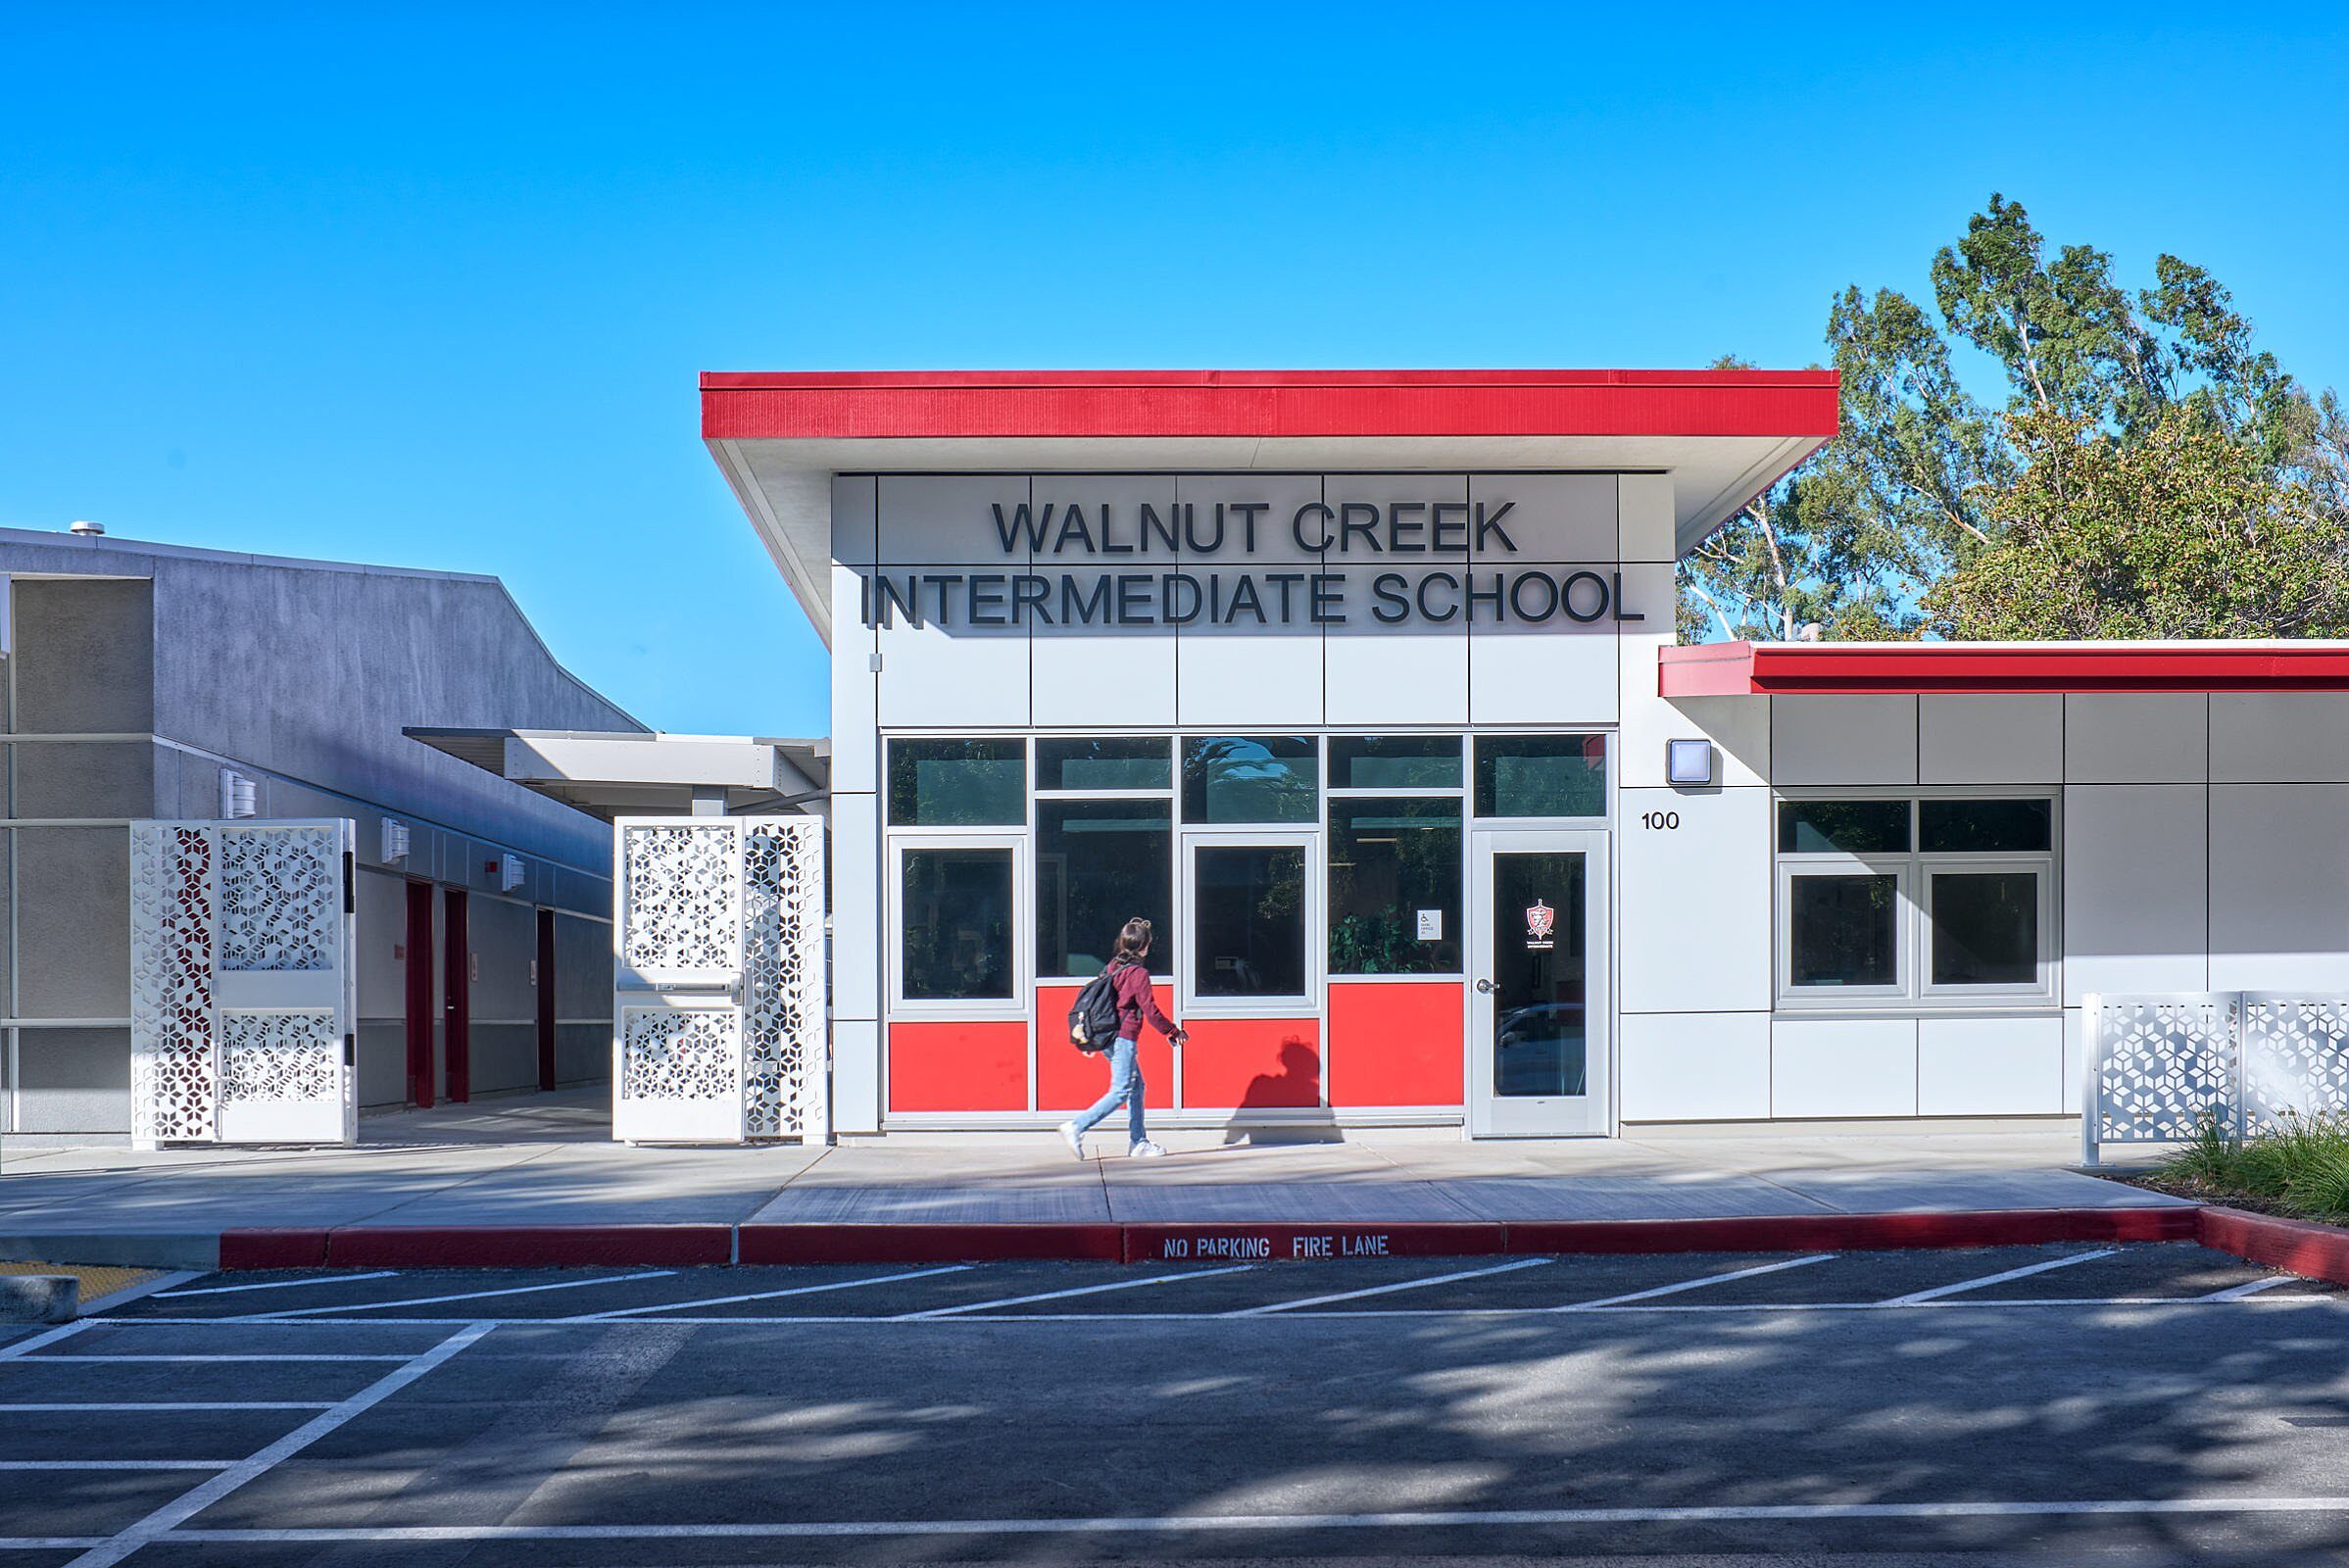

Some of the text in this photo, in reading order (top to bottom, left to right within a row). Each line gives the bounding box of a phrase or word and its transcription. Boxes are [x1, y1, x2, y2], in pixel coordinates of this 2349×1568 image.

[993, 502, 1519, 554] WALNUT CREEK
[862, 571, 1645, 625] INTERMEDIATE SCHOOL
[1641, 811, 1679, 830] 100
[1164, 1235, 1390, 1258] NO PARKING FIRE LANE
